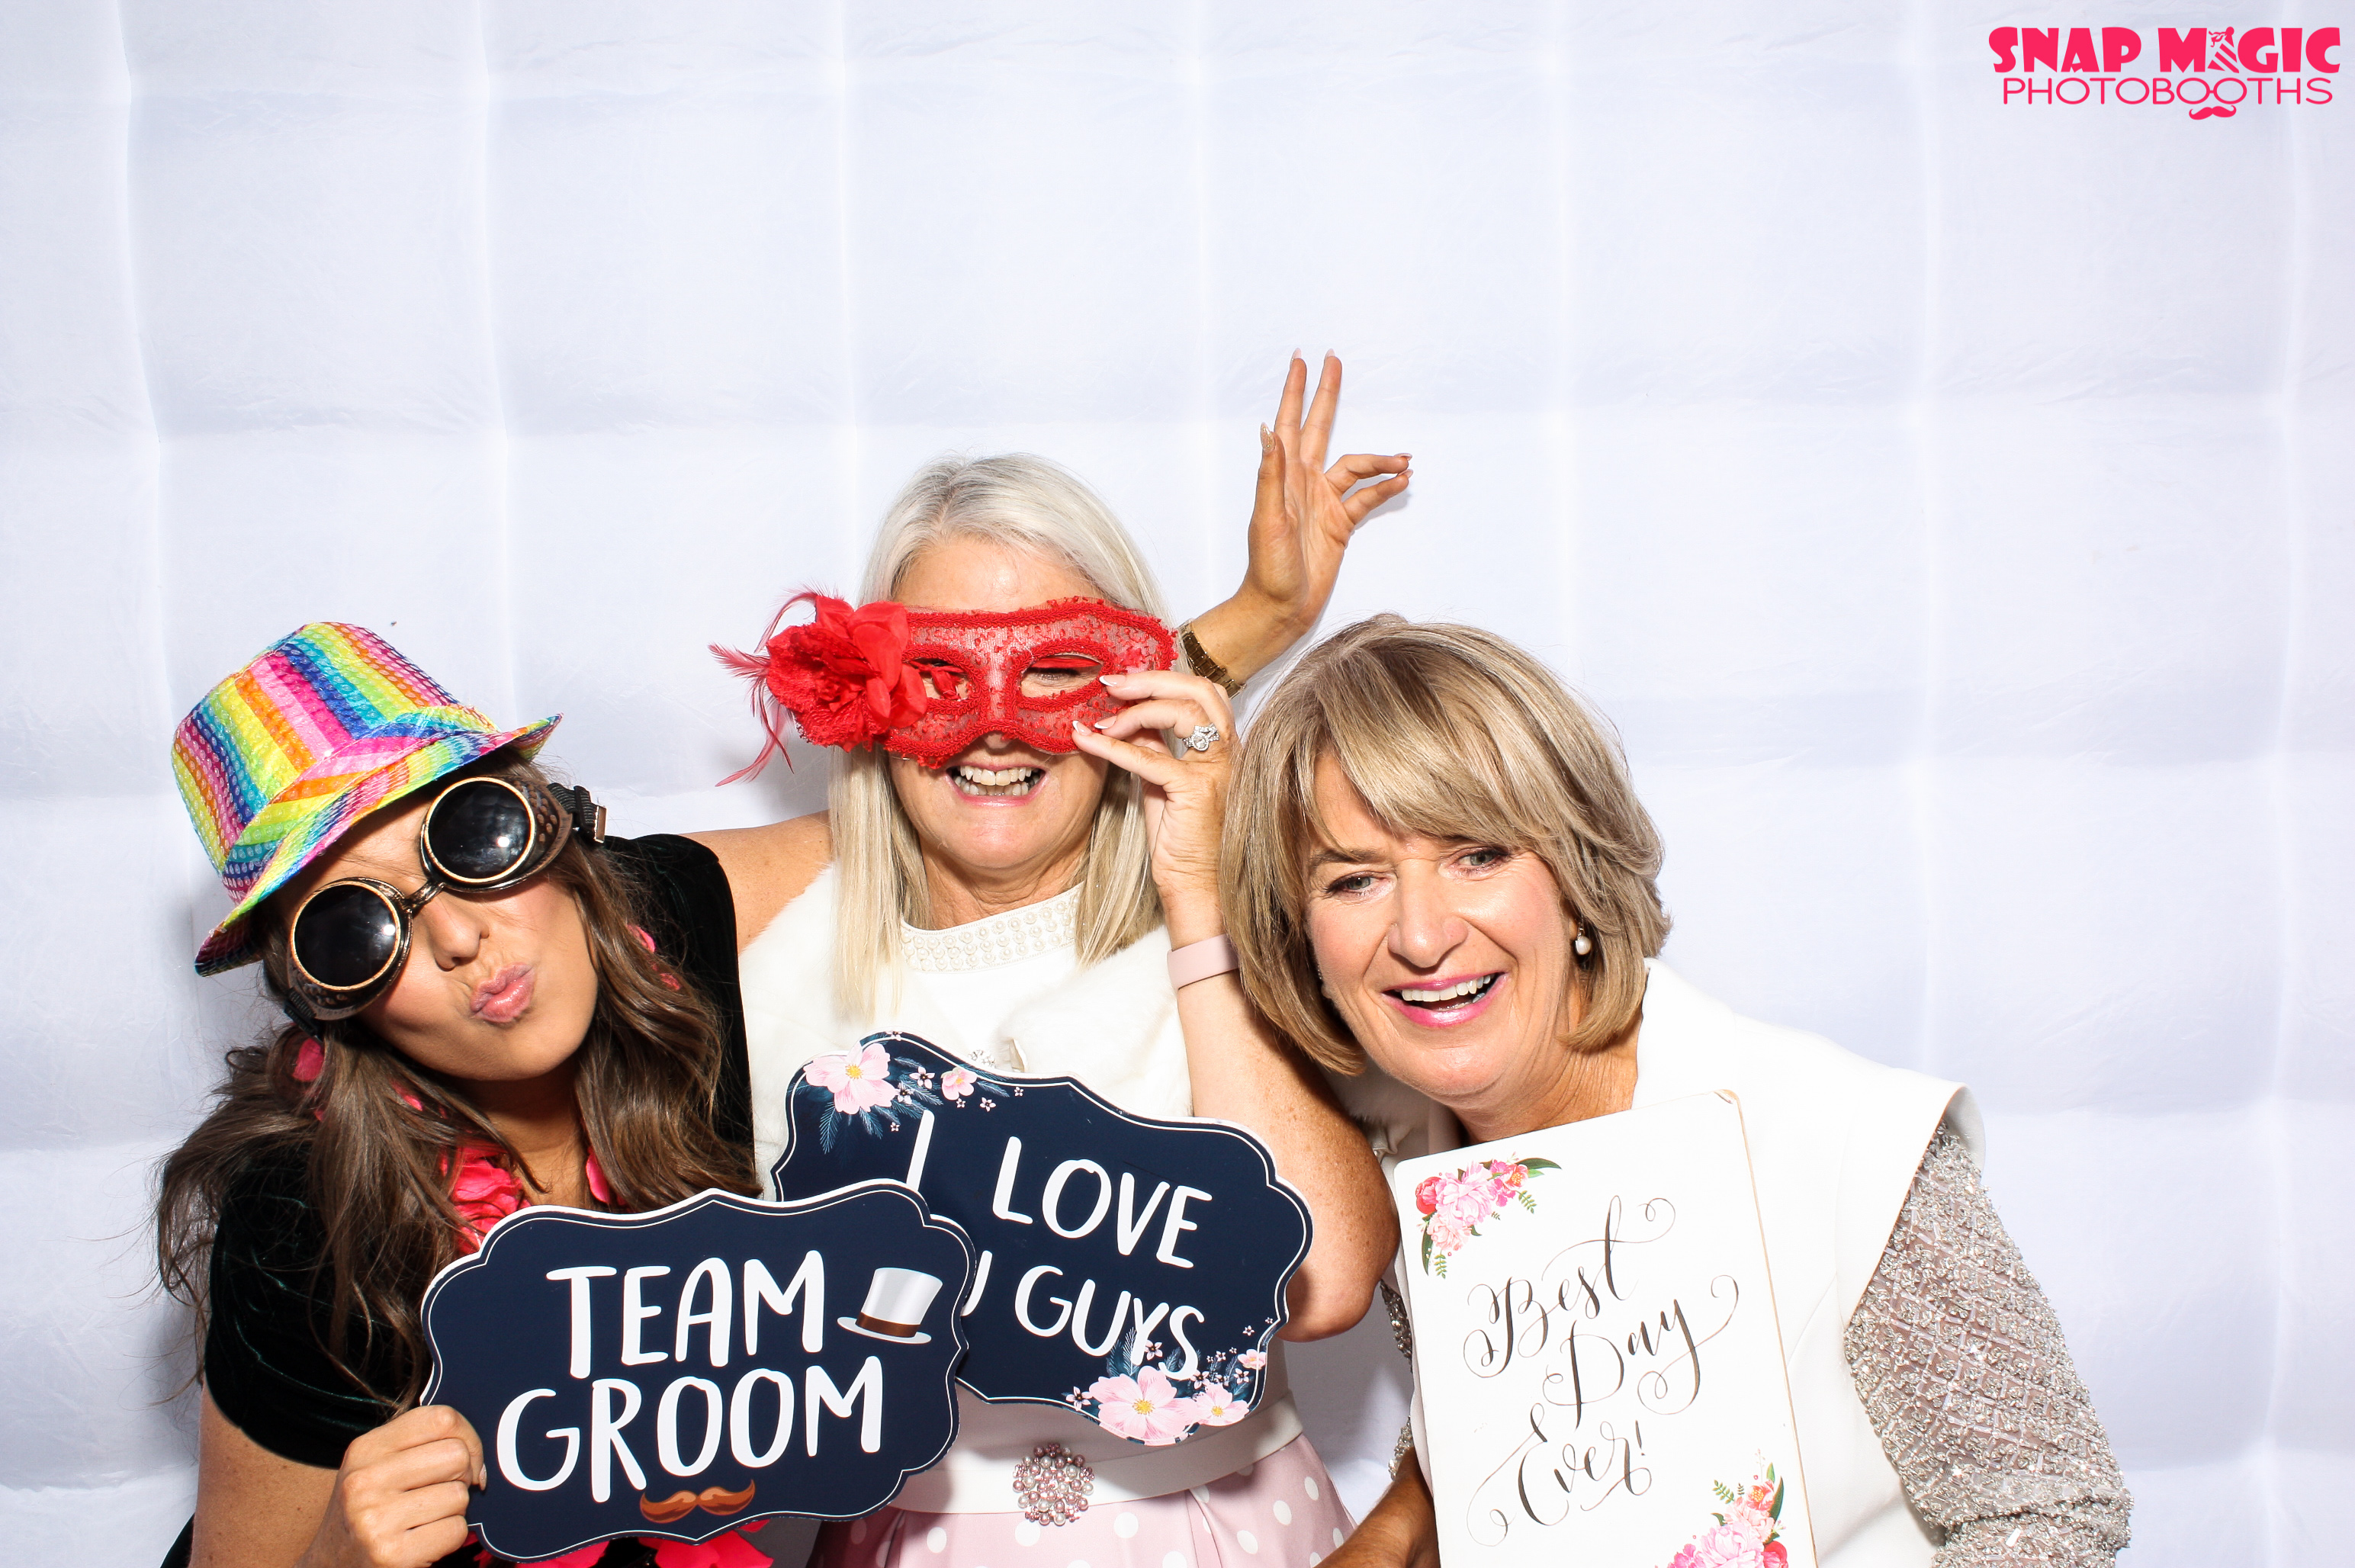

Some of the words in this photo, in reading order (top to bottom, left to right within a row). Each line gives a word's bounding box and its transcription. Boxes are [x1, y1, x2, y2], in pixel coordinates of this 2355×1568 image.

[991, 1136, 1213, 1269] LOVE
[545, 1250, 825, 1379] TEAM
[1014, 1264, 1205, 1380] GUYS
[1462, 1195, 1676, 1378] Best
[1542, 1274, 1740, 1431] Day
[496, 1355, 884, 1503] GROOM
[1466, 1403, 1653, 1547] Ever!
